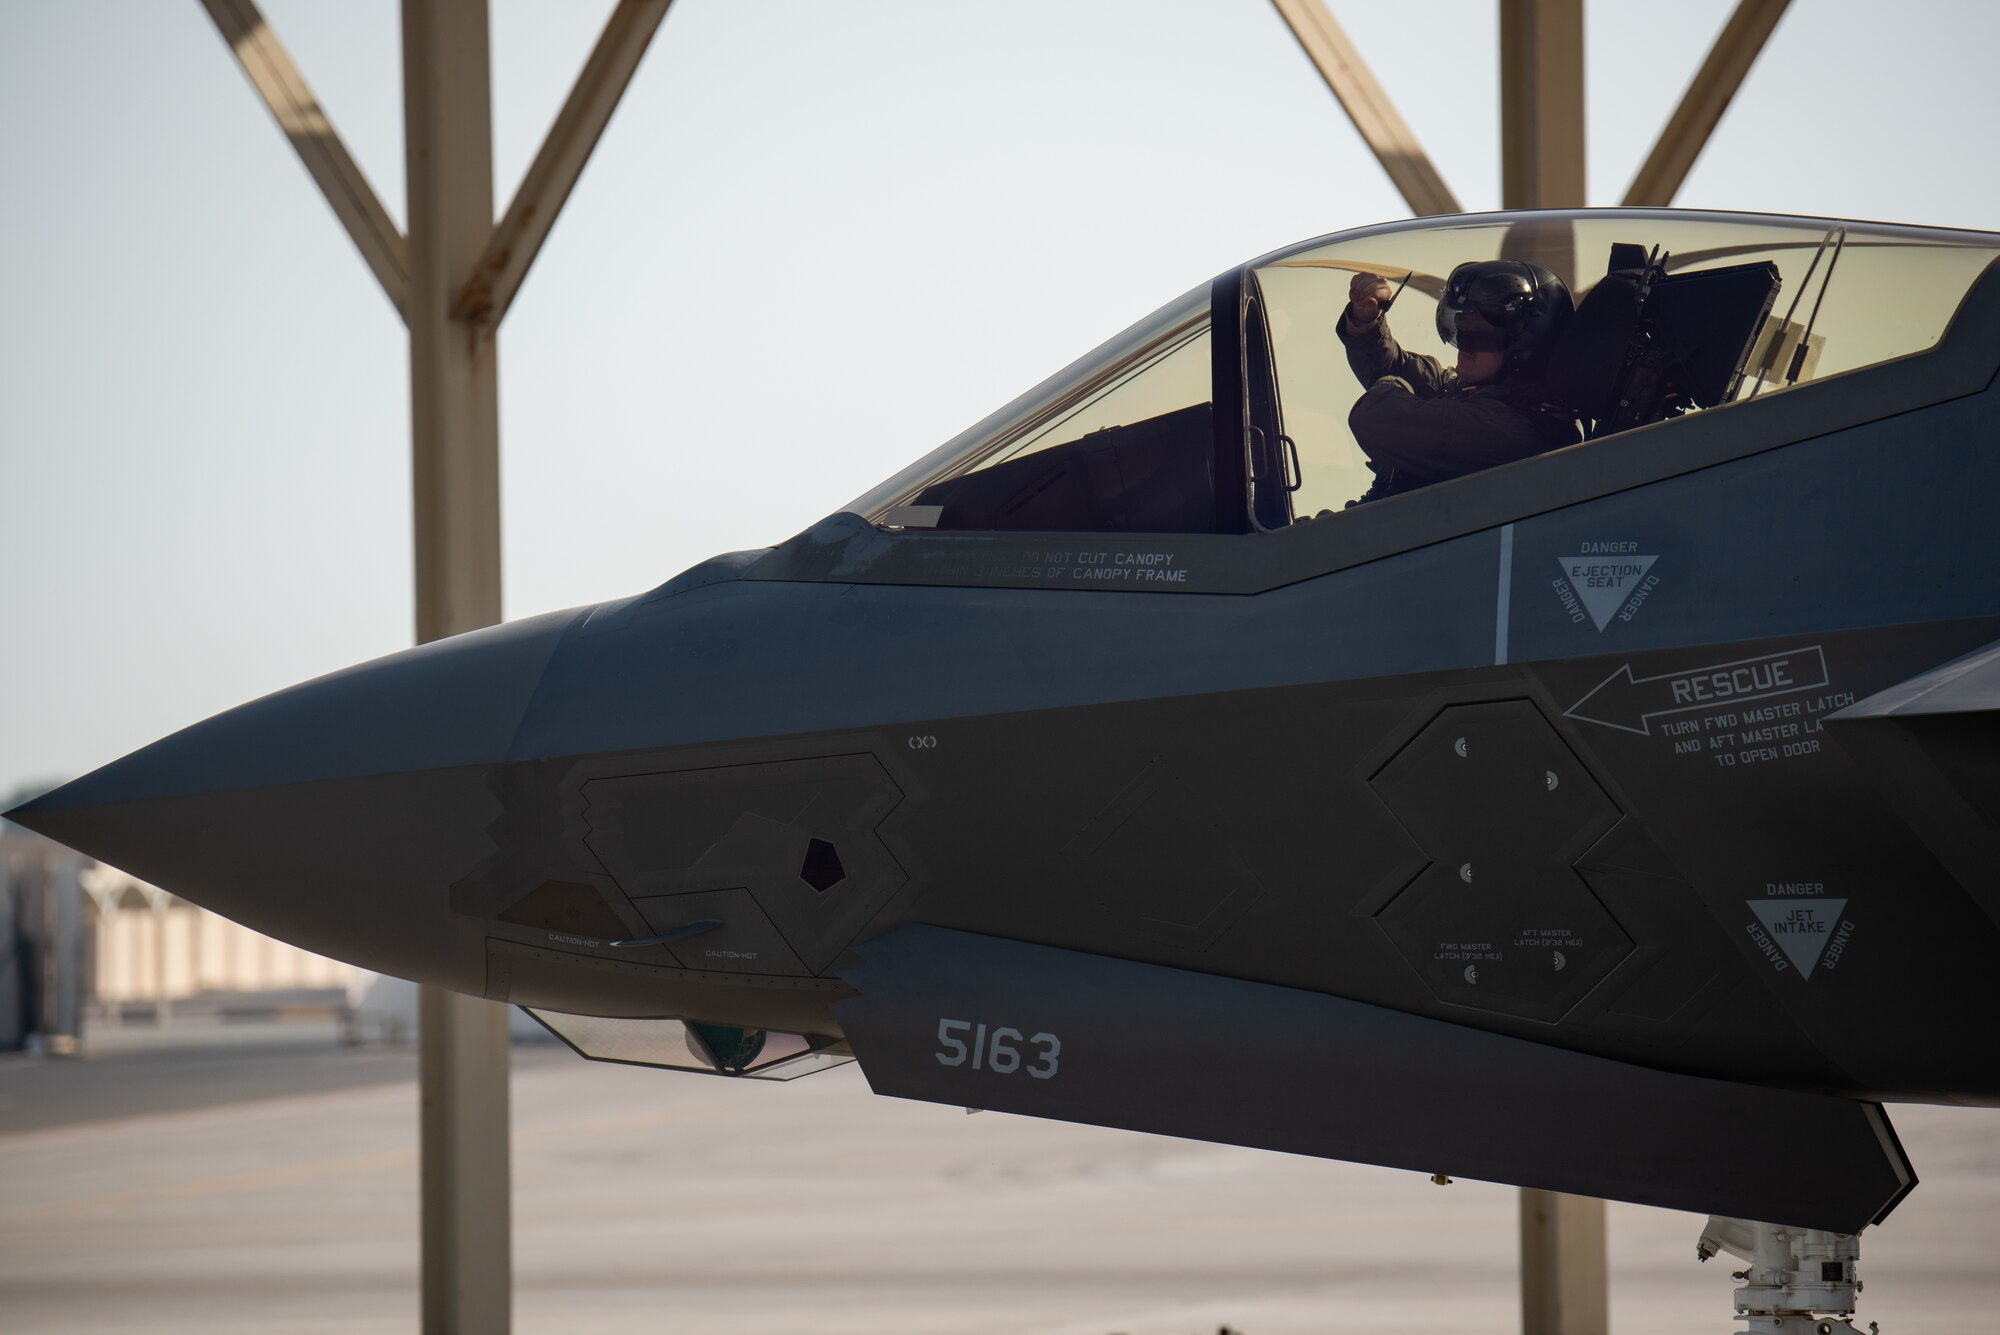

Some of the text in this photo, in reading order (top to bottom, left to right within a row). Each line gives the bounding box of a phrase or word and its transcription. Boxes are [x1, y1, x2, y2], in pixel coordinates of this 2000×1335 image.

[1581, 541, 1638, 553] DANGER
[1046, 552, 1072, 564] NOT
[1078, 552, 1108, 565] CUT
[1115, 553, 1174, 566] CANOPY
[989, 566, 1041, 578] INCHES
[1047, 567, 1066, 579] OF
[1073, 568, 1131, 580] CANOPY
[1135, 569, 1187, 582] FRAME
[1572, 565, 1642, 577] EJECTION
[1587, 577, 1624, 588] SEAT
[1552, 577, 1586, 624] DANGER
[1619, 574, 1660, 622] DANGER
[1670, 660, 1794, 704] RESCUE
[1660, 691, 1855, 738] TURN FWD MASTER LATCH
[1674, 739, 1701, 755] AND
[1709, 735, 1736, 750] AFT
[1742, 724, 1799, 745] MASTER
[1715, 739, 1822, 768] TO OPEN DOOR
[1766, 883, 1824, 895] DANGER
[1786, 909, 1814, 921] JET
[1522, 929, 1571, 937] AFT MASTER
[1774, 921, 1826, 934] INTAKE
[548, 933, 600, 948] CAUTION-HOT
[1440, 943, 1492, 951] FWD MASTER
[1514, 938, 1540, 946] LATCH
[1565, 938, 1583, 947] HEX)
[1746, 920, 1788, 971] DANGER
[1820, 919, 1855, 970] DANGER
[705, 949, 758, 960] CAUTION-HOT
[1434, 952, 1460, 960] LATCH
[1485, 952, 1503, 961] HEX)
[935, 1018, 1061, 1080] 5163
